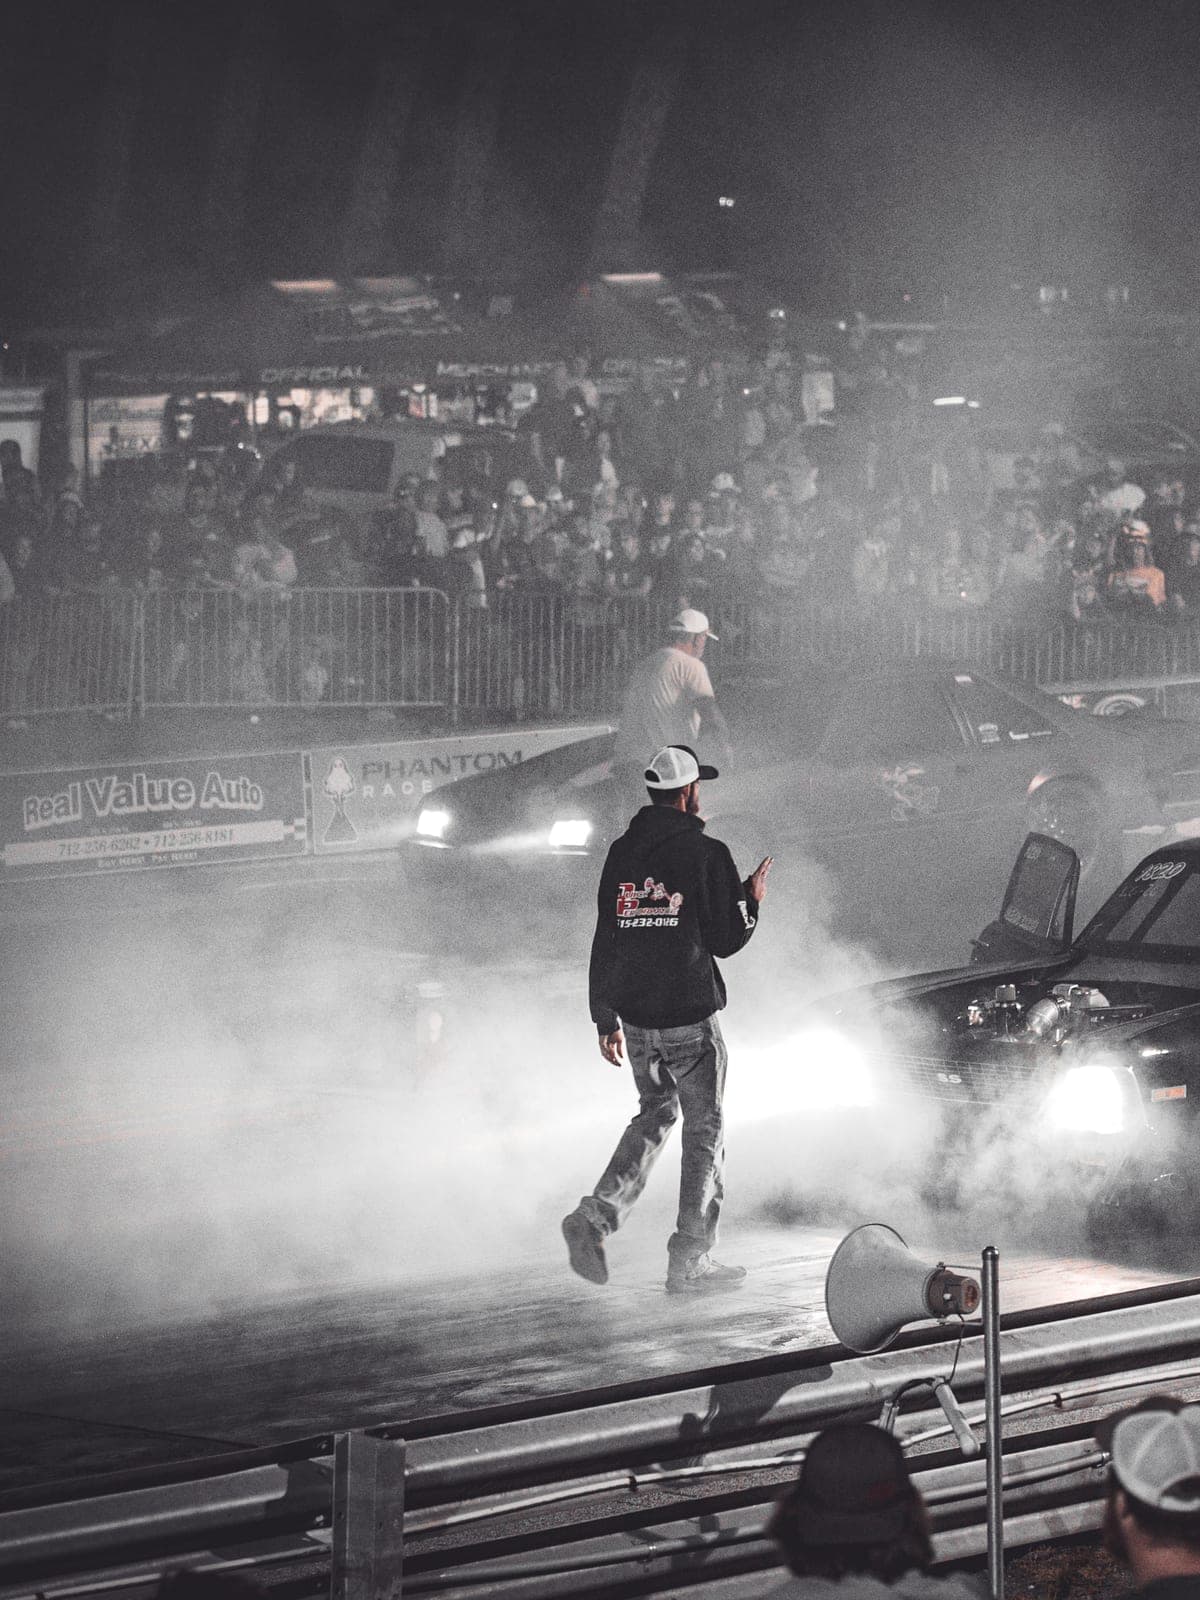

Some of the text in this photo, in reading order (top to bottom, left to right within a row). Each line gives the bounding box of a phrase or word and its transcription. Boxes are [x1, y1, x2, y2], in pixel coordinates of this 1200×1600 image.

[361, 750, 523, 781] PHANTOM
[24, 772, 264, 831] Real Value Auto
